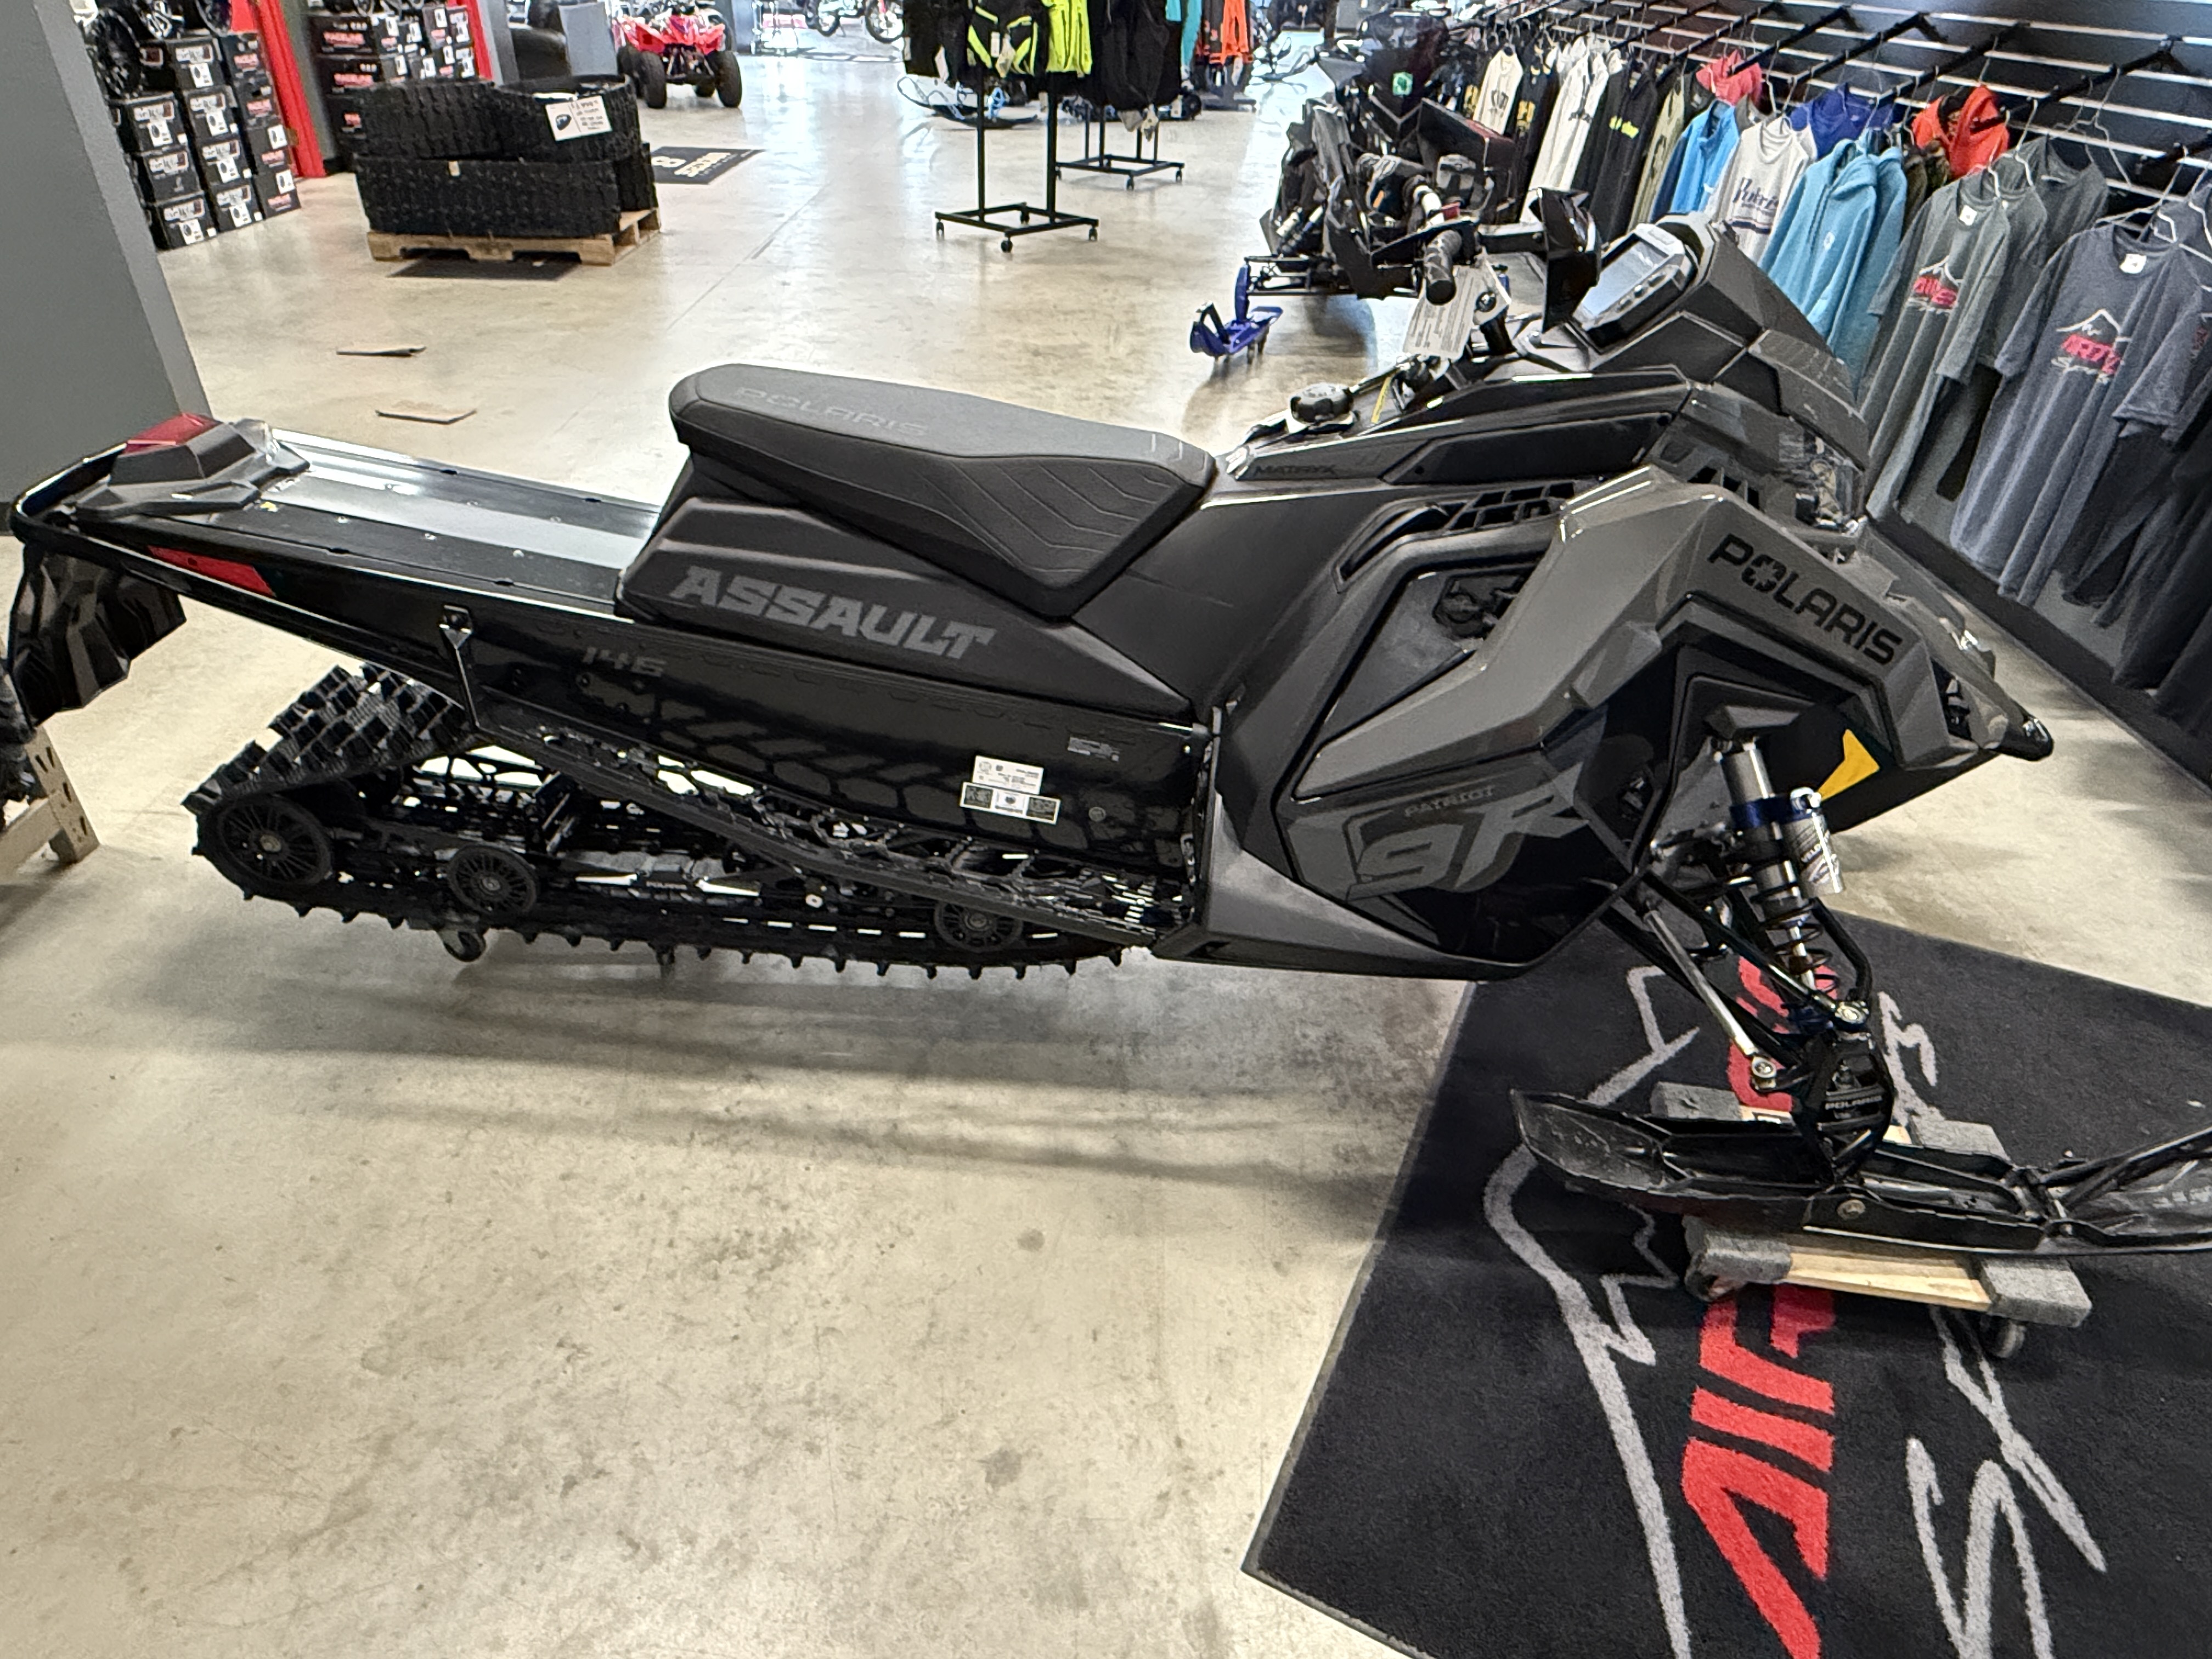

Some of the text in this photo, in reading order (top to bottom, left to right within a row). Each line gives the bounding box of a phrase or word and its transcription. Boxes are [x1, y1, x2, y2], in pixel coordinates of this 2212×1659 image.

[732, 386, 928, 437] POLARIS
[669, 565, 997, 659] ASSAULT
[1707, 533, 1903, 665] POLARIS
[1404, 785, 1496, 817] PATRIOT
